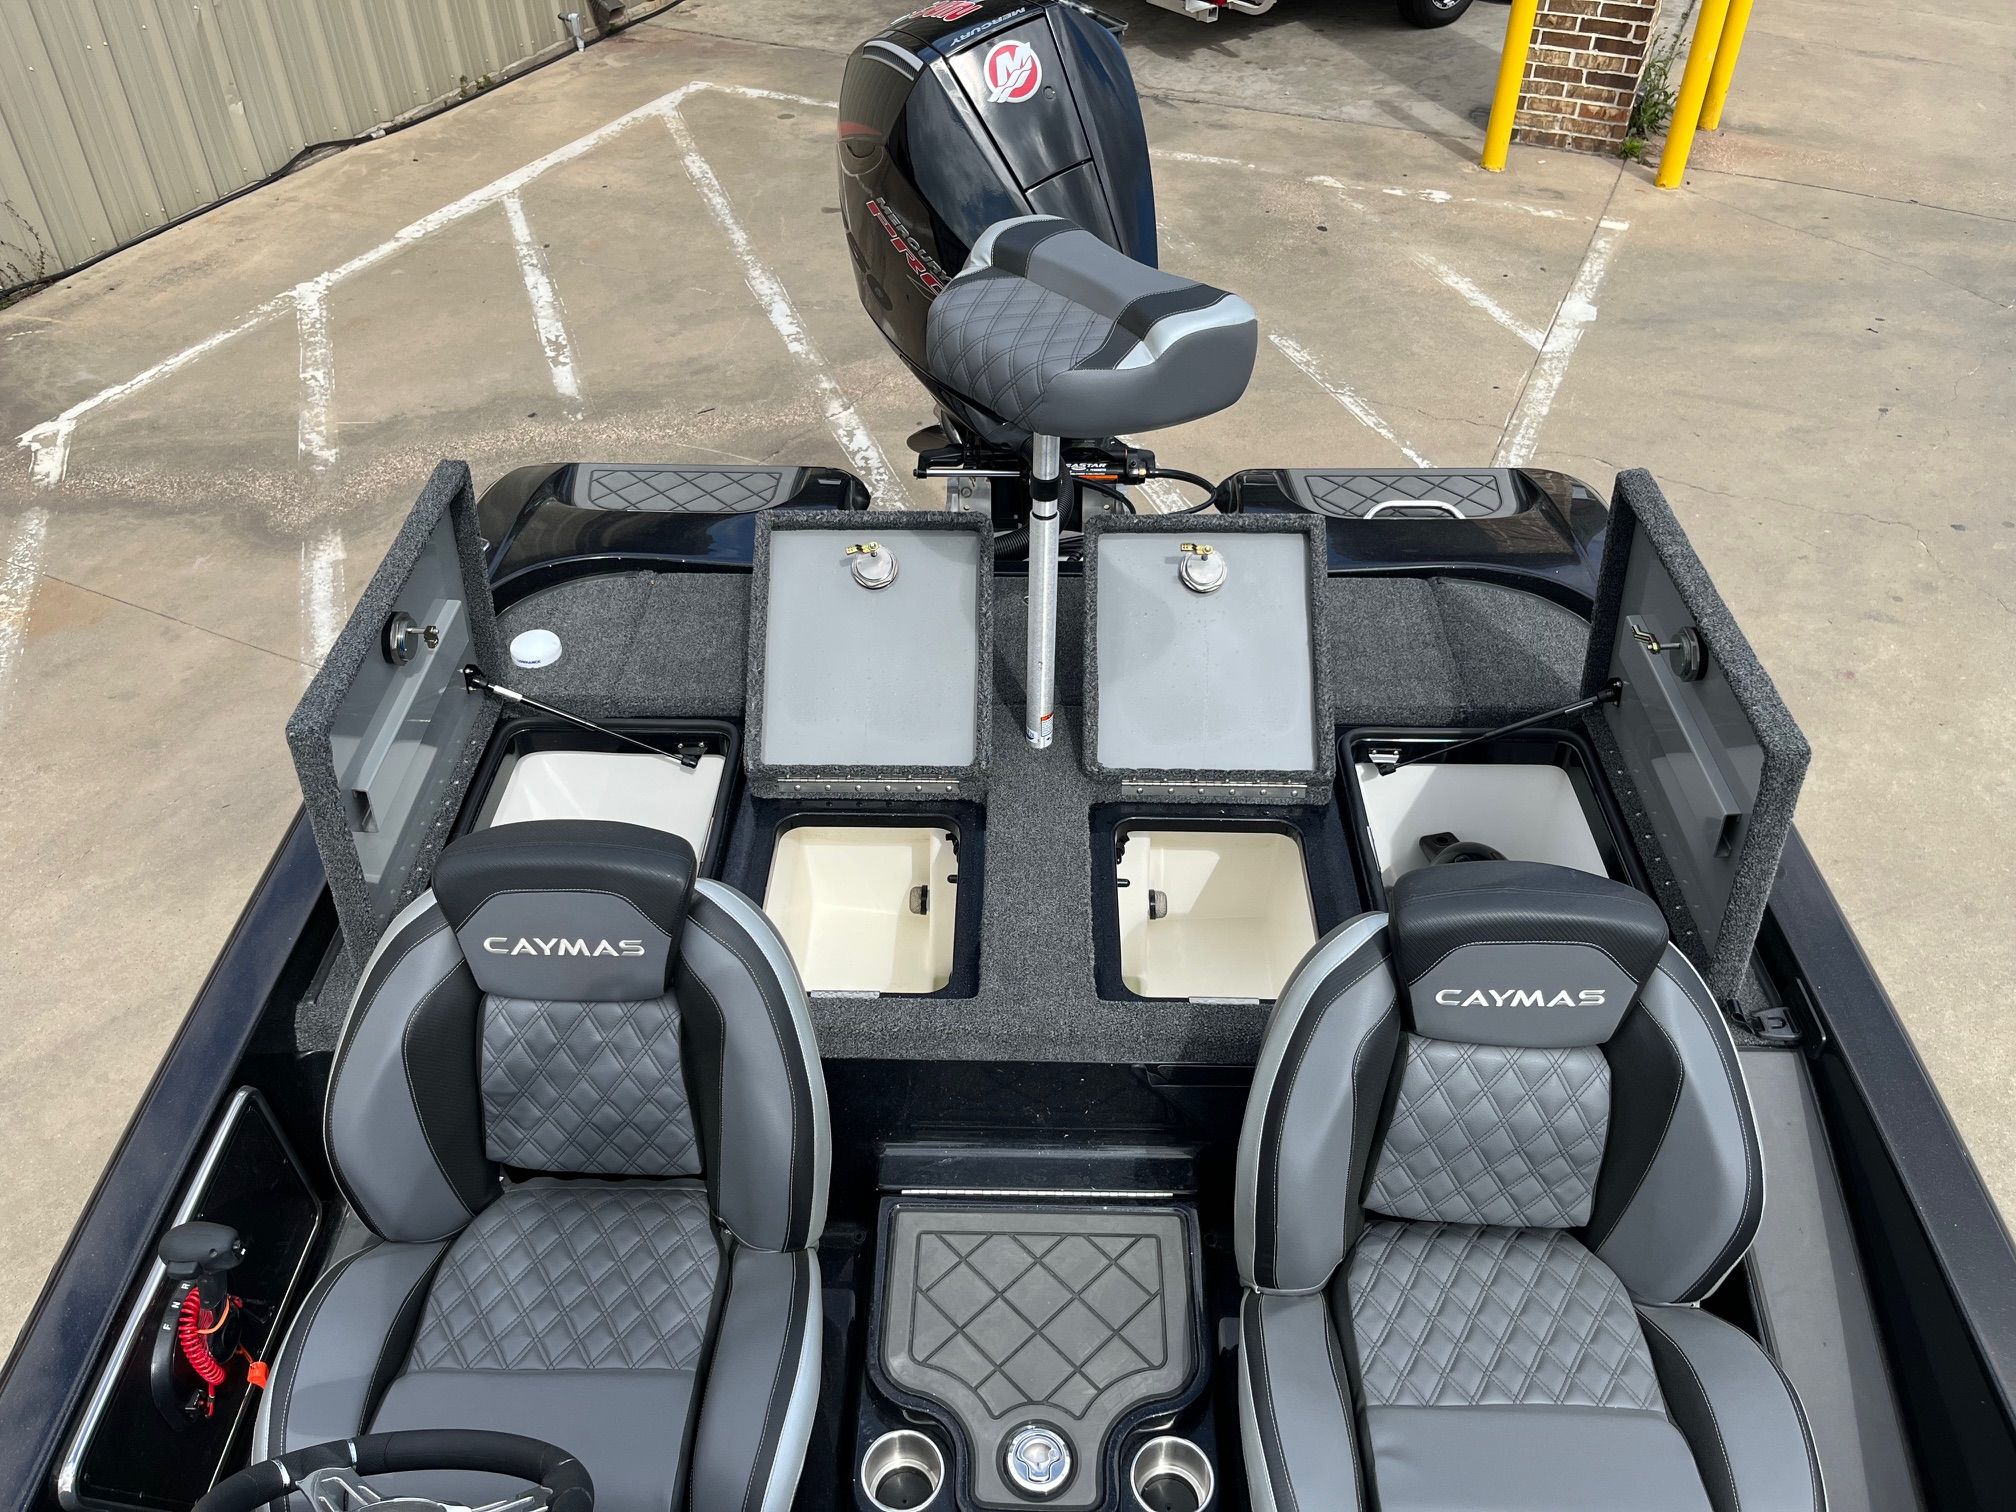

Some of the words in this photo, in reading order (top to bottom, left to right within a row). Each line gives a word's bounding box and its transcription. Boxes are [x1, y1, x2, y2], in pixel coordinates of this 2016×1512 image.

[949, 7, 1026, 47] MERCURY
[876, 196, 953, 281] MERCURY
[483, 936, 645, 958] CAYMAS
[1434, 989, 1606, 1007] CAYMAS
